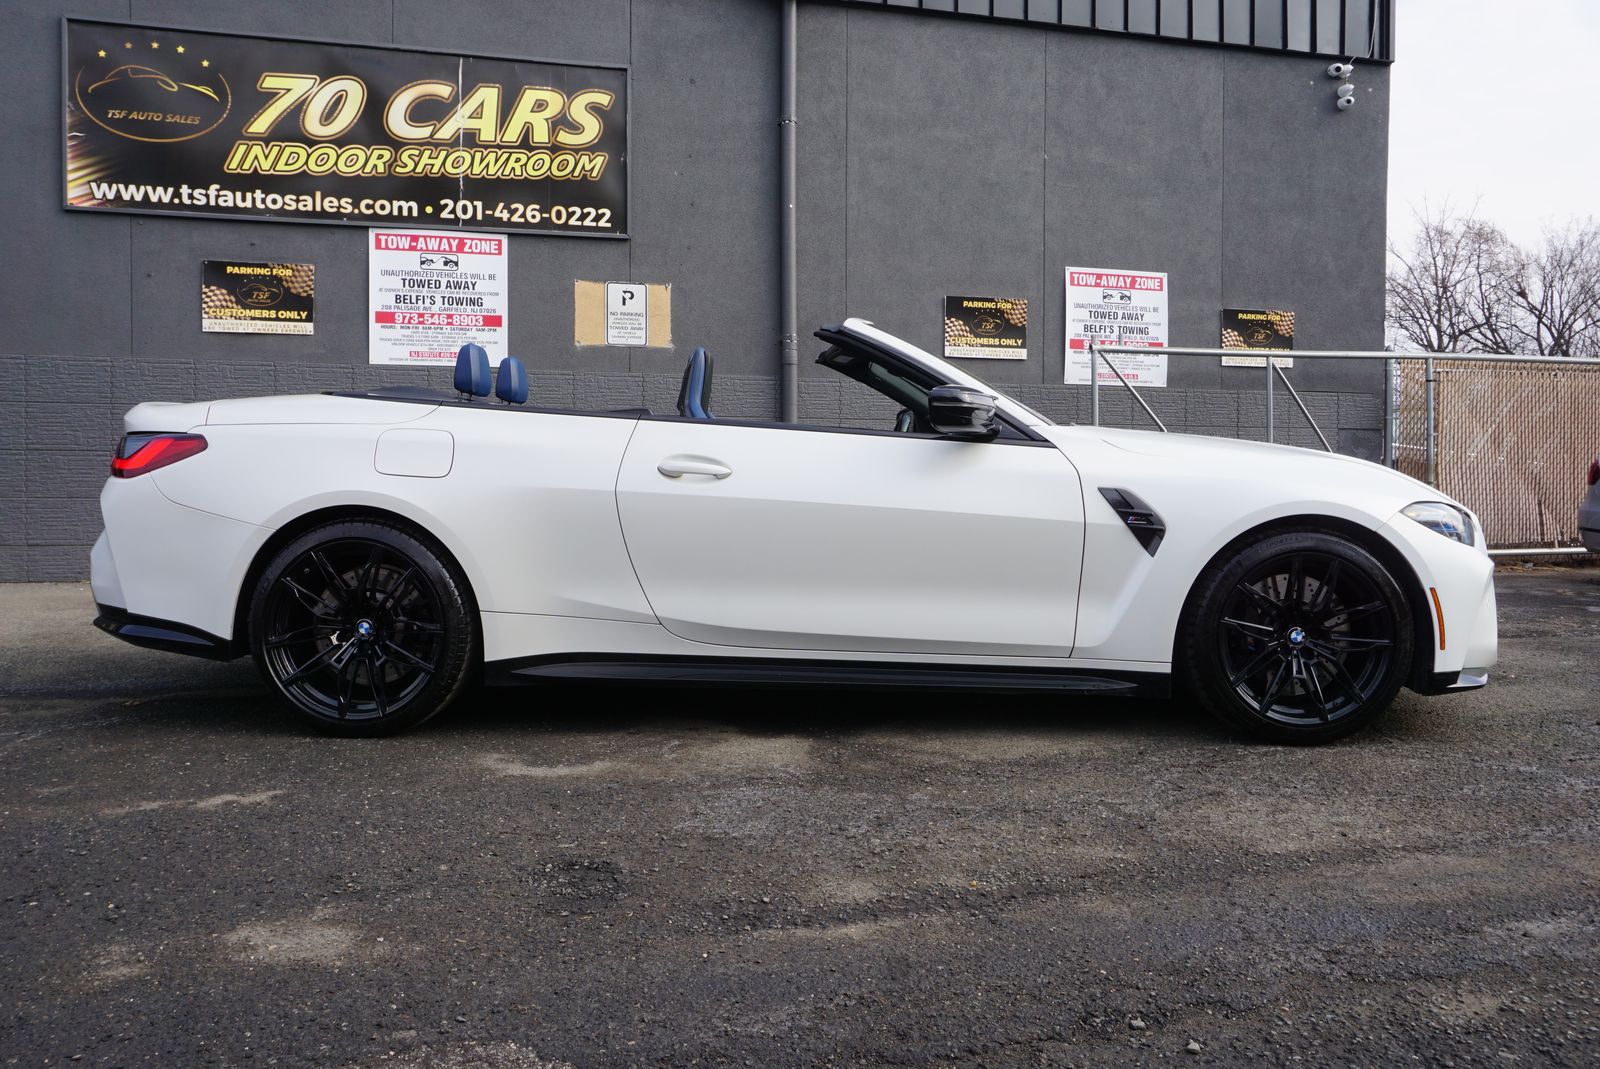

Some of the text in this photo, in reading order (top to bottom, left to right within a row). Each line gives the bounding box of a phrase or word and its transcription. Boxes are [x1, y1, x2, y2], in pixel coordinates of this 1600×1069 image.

[242, 72, 615, 148] 70 CARS
[107, 109, 200, 125] TSF AUTO SALES
[224, 140, 608, 180] INDOOR SHOWROOM
[89, 181, 612, 228] www.tsfautosales.com 201-426-0222
[379, 234, 498, 253] TOW-AWAY ZONE
[227, 266, 293, 277] PARKING FOR
[380, 269, 435, 278] UNAUTHORIZED
[435, 271, 468, 280] VEHICLES
[401, 278, 477, 291] TOWED AWAY
[1072, 273, 1160, 289] TOW-AWAY ZONE
[252, 291, 271, 300] TSF
[394, 294, 484, 307] BELFI'S TOWING
[963, 301, 996, 309] PARKING
[1073, 302, 1114, 311] UNAUTHORIZED
[1114, 304, 1138, 312] VEHICLES
[209, 308, 308, 320] CUSTOMERS ONLY
[394, 312, 484, 326] 973-546-8903
[1088, 310, 1145, 321] TOWED AWAY
[1083, 324, 1150, 336] BELFI'S TOWING
[950, 338, 1000, 346] CUSTOMERS
